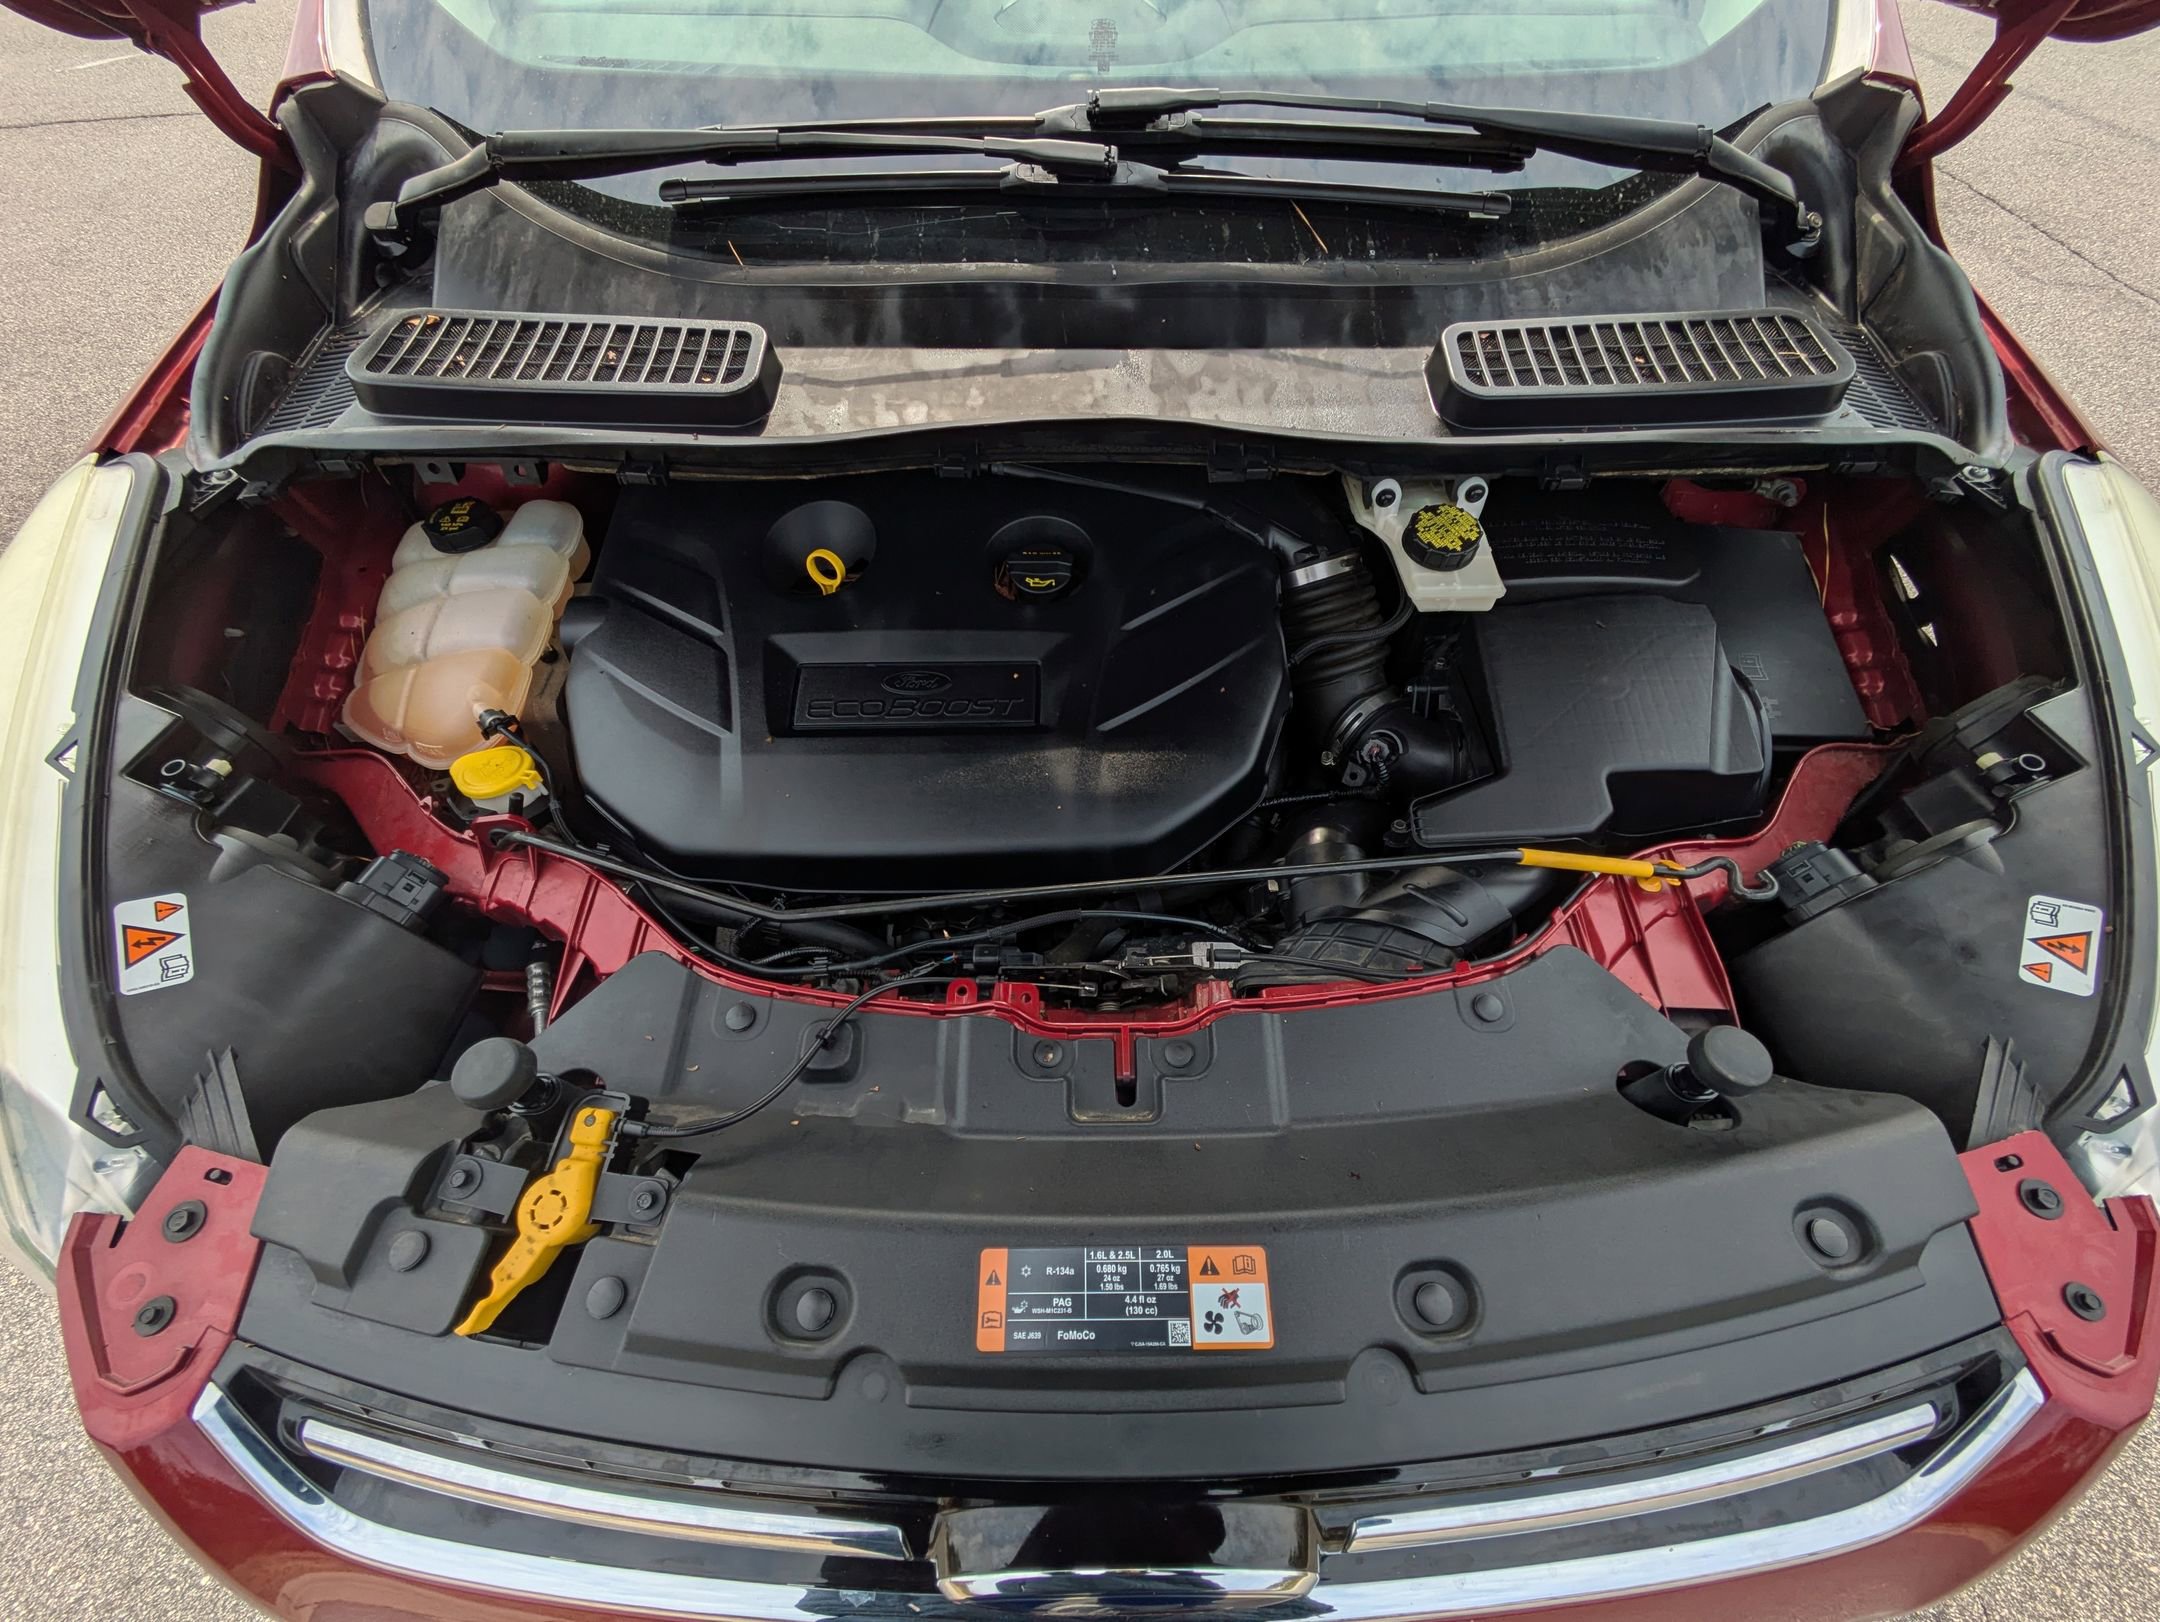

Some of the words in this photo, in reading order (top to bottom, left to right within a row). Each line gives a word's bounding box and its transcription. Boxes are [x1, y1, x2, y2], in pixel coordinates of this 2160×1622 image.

[894, 673, 939, 688] Ford
[1089, 1250, 1107, 1260] 1.6L
[1109, 1250, 1116, 1260] &
[1117, 1250, 1136, 1260] 2.5L
[1155, 1249, 1174, 1259] 2.0L
[1045, 1266, 1075, 1276] R-134a
[1096, 1264, 1116, 1273] 0.680
[1117, 1264, 1127, 1275] kg
[1149, 1263, 1170, 1273] 0.765
[1171, 1263, 1181, 1275] kg
[1100, 1283, 1114, 1291] 1.50
[1114, 1283, 1124, 1291] lbs
[1154, 1282, 1167, 1290] 1.69
[1168, 1282, 1178, 1290] lbs
[1053, 1297, 1072, 1307] PAG
[1124, 1295, 1138, 1304] 4.4
[1138, 1295, 1145, 1304] fl
[1125, 1306, 1143, 1317] (130
[1144, 1306, 1158, 1317] cc)
[1013, 1331, 1026, 1340] SAE
[1027, 1331, 1042, 1340] J639
[1057, 1330, 1096, 1340] FoMoCo
